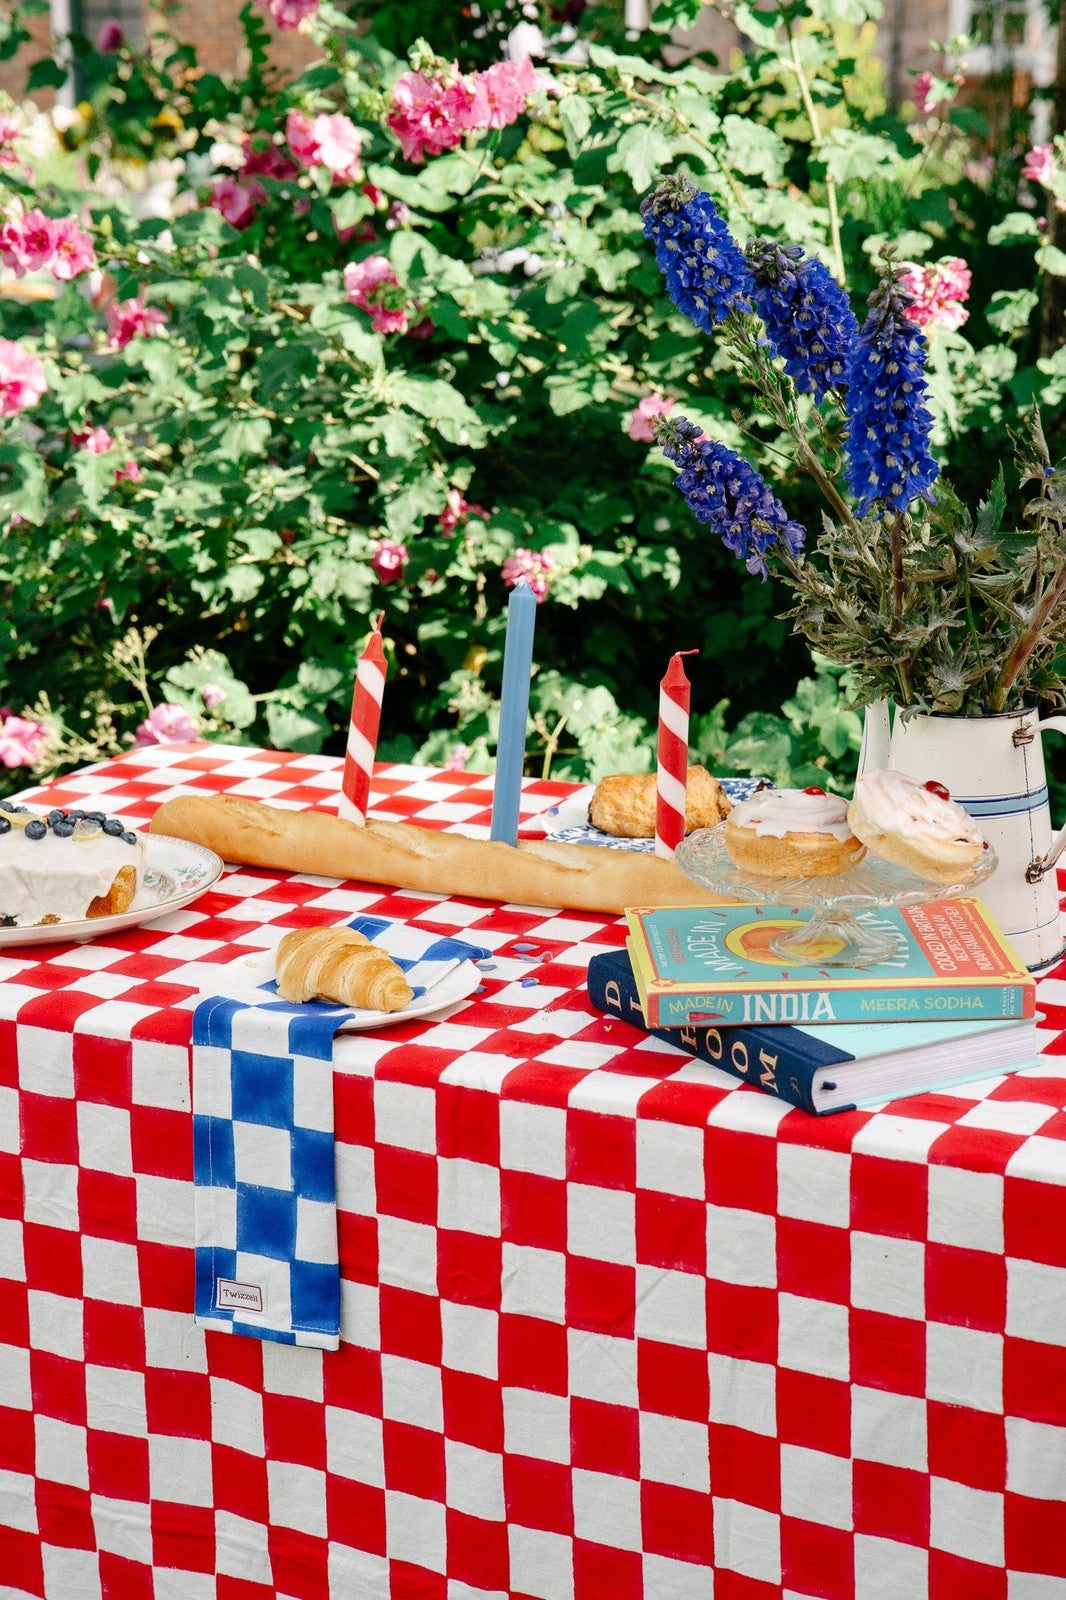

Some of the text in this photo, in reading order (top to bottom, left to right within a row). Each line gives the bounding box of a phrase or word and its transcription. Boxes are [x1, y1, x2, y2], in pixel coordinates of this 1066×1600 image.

[942, 906, 968, 929] KITCHEN
[687, 920, 743, 971] MADE IN
[920, 932, 940, 941] IN
[930, 914, 970, 961] RECIPES FROM AN
[957, 929, 981, 950] FAMILY
[925, 941, 957, 971] COOKED
[969, 950, 995, 970] INDIAN
[669, 993, 836, 1022] MADE IN INDIA
[860, 997, 983, 1011] MEERA SODHA
[605, 980, 779, 1093] DIHOOM
[223, 1289, 258, 1302] Twizzell
